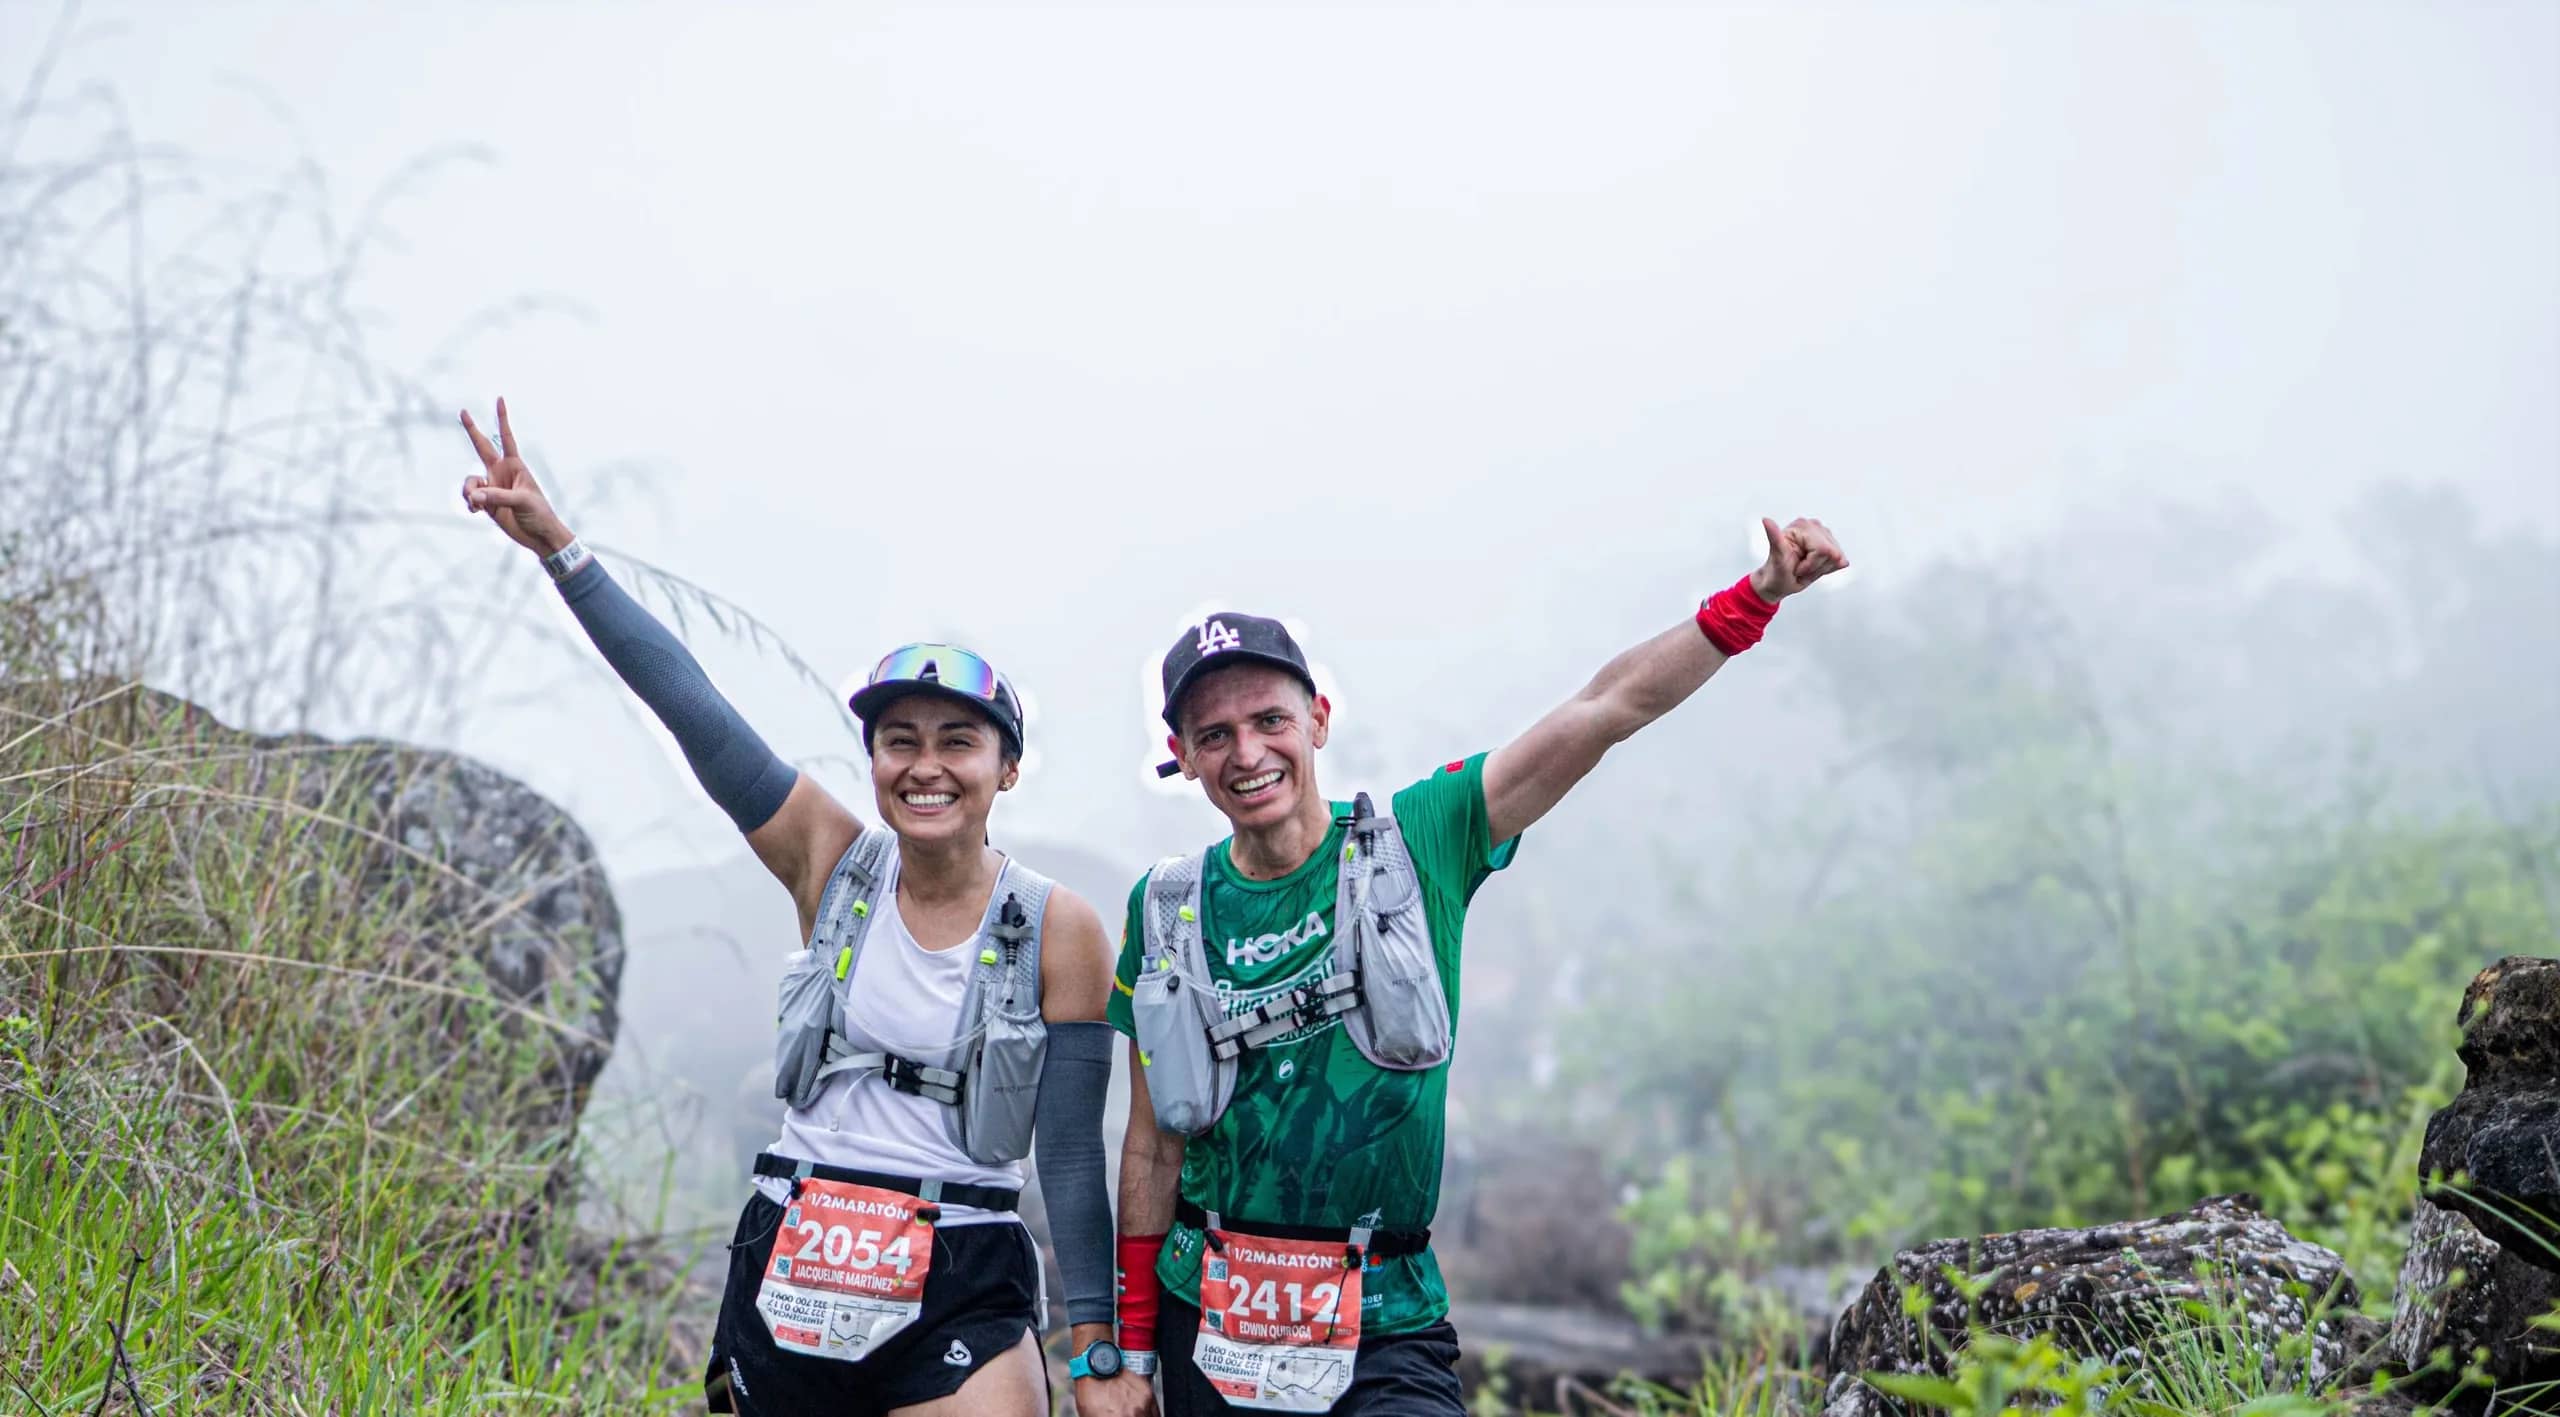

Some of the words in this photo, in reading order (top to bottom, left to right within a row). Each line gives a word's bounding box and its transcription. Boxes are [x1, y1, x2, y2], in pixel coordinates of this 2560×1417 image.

[1196, 618, 1241, 657] LA
[1226, 911, 1328, 967] HOKA
[811, 1193, 909, 1221] 1/2MARATÓN
[795, 1220, 913, 1277] 2054
[1234, 1247, 1333, 1269] 1/2MARATÓN
[795, 1264, 844, 1284] JACQUELINE
[845, 1272, 894, 1292] MARTÍNEZ
[795, 1296, 812, 1306] 700
[813, 1300, 828, 1309] 322
[1227, 1275, 1342, 1324] 2412
[792, 1305, 810, 1315] 700
[811, 1309, 827, 1318] 322
[1240, 1320, 1268, 1337] EDWIN
[1269, 1324, 1312, 1340] QUIROGA
[1205, 1344, 1226, 1355] 0091
[1228, 1350, 1245, 1360] 700
[1202, 1353, 1224, 1364] 0117
[1225, 1357, 1243, 1367] 700
[1247, 1352, 1264, 1362] 322
[1245, 1360, 1262, 1370] 322
